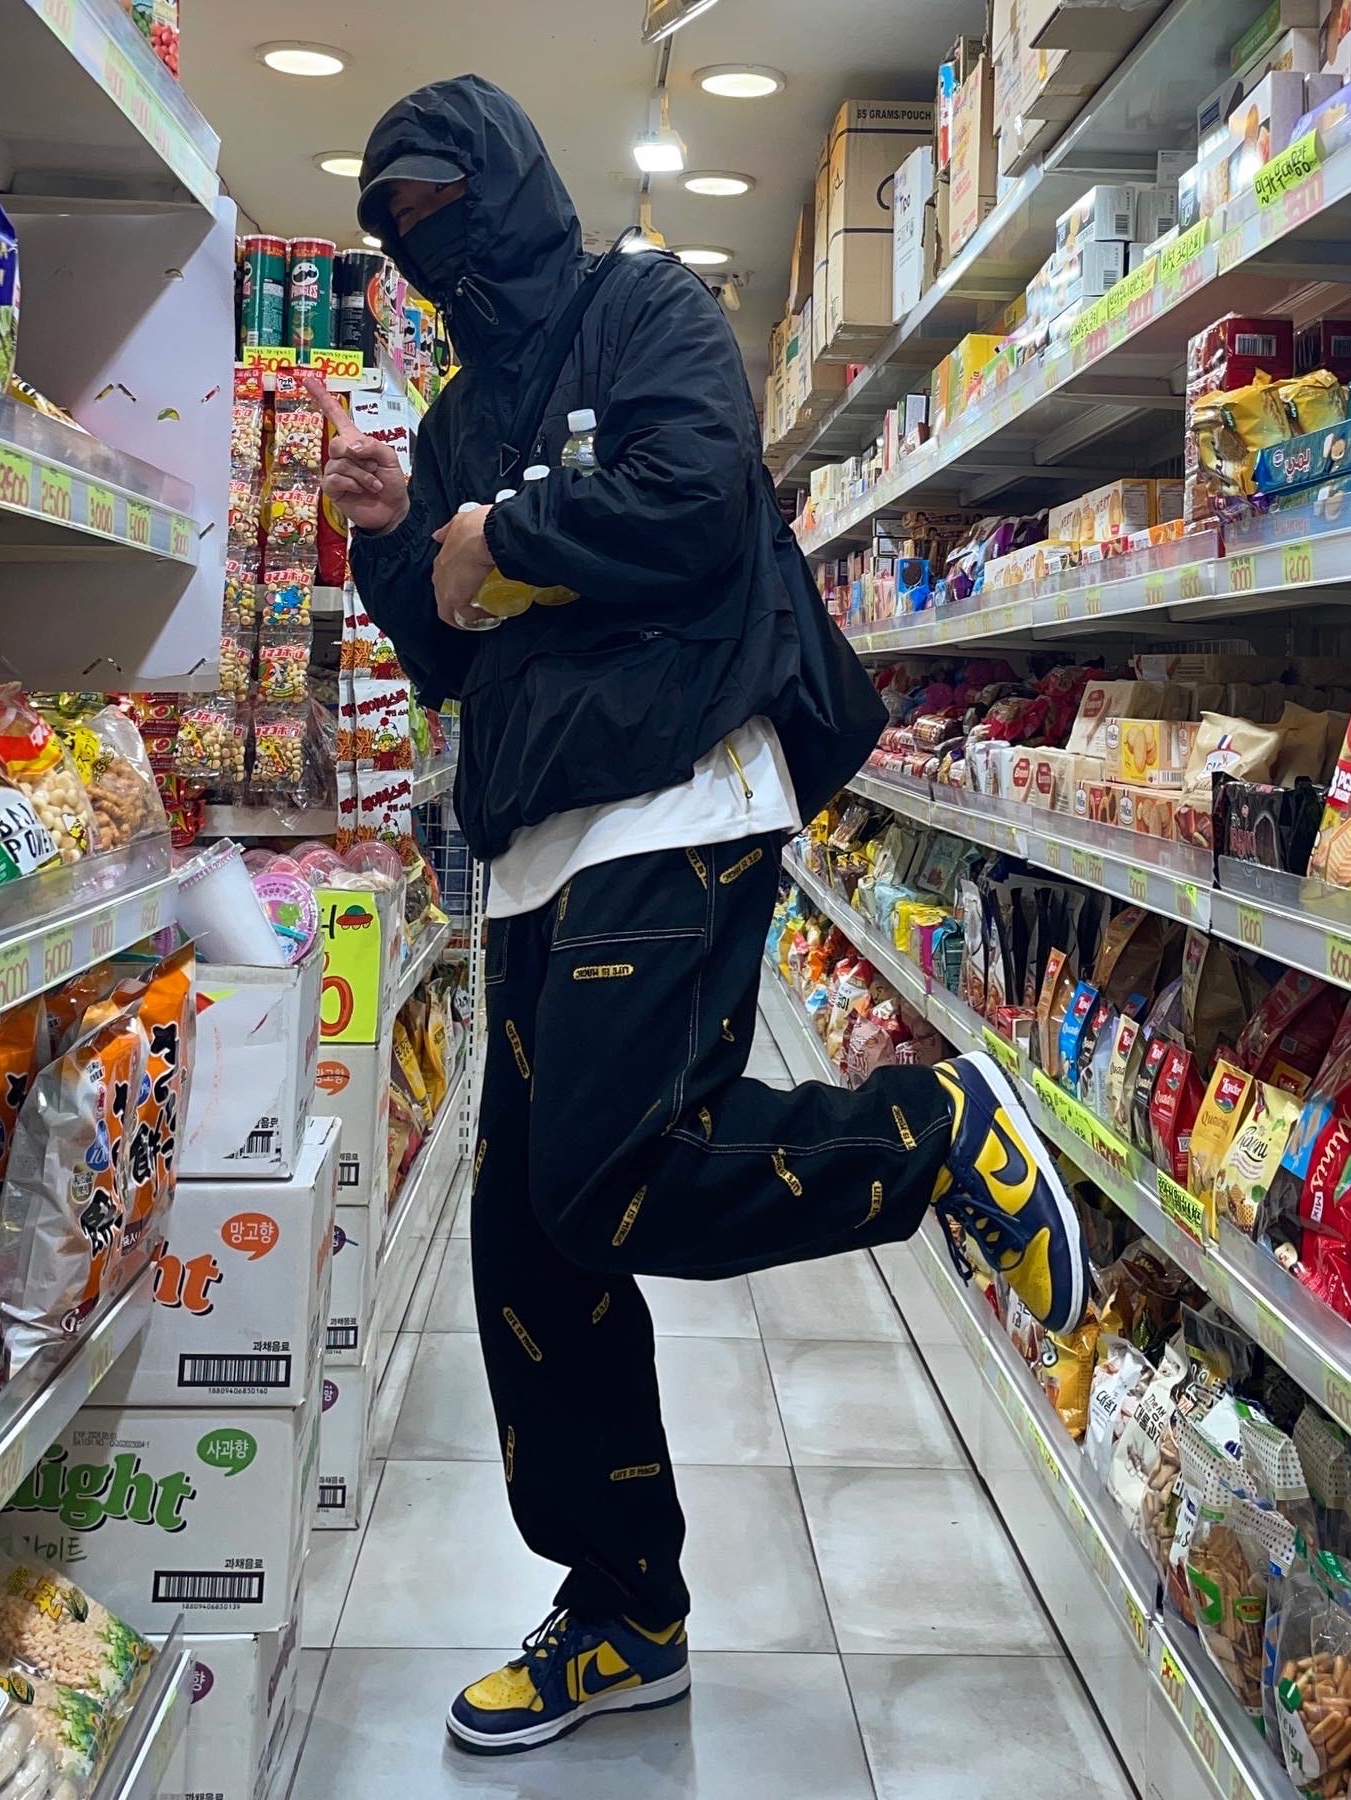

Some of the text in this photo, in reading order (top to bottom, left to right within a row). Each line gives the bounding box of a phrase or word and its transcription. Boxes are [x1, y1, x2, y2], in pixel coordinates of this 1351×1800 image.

[314, 356, 361, 377] 2500
[1311, 1195, 1322, 1222] MIX
[230, 1222, 275, 1244] 망고향
[252, 1341, 291, 1353] 과채음료
[206, 1440, 249, 1460] 사과향
[224, 1558, 263, 1570] 과채음료
